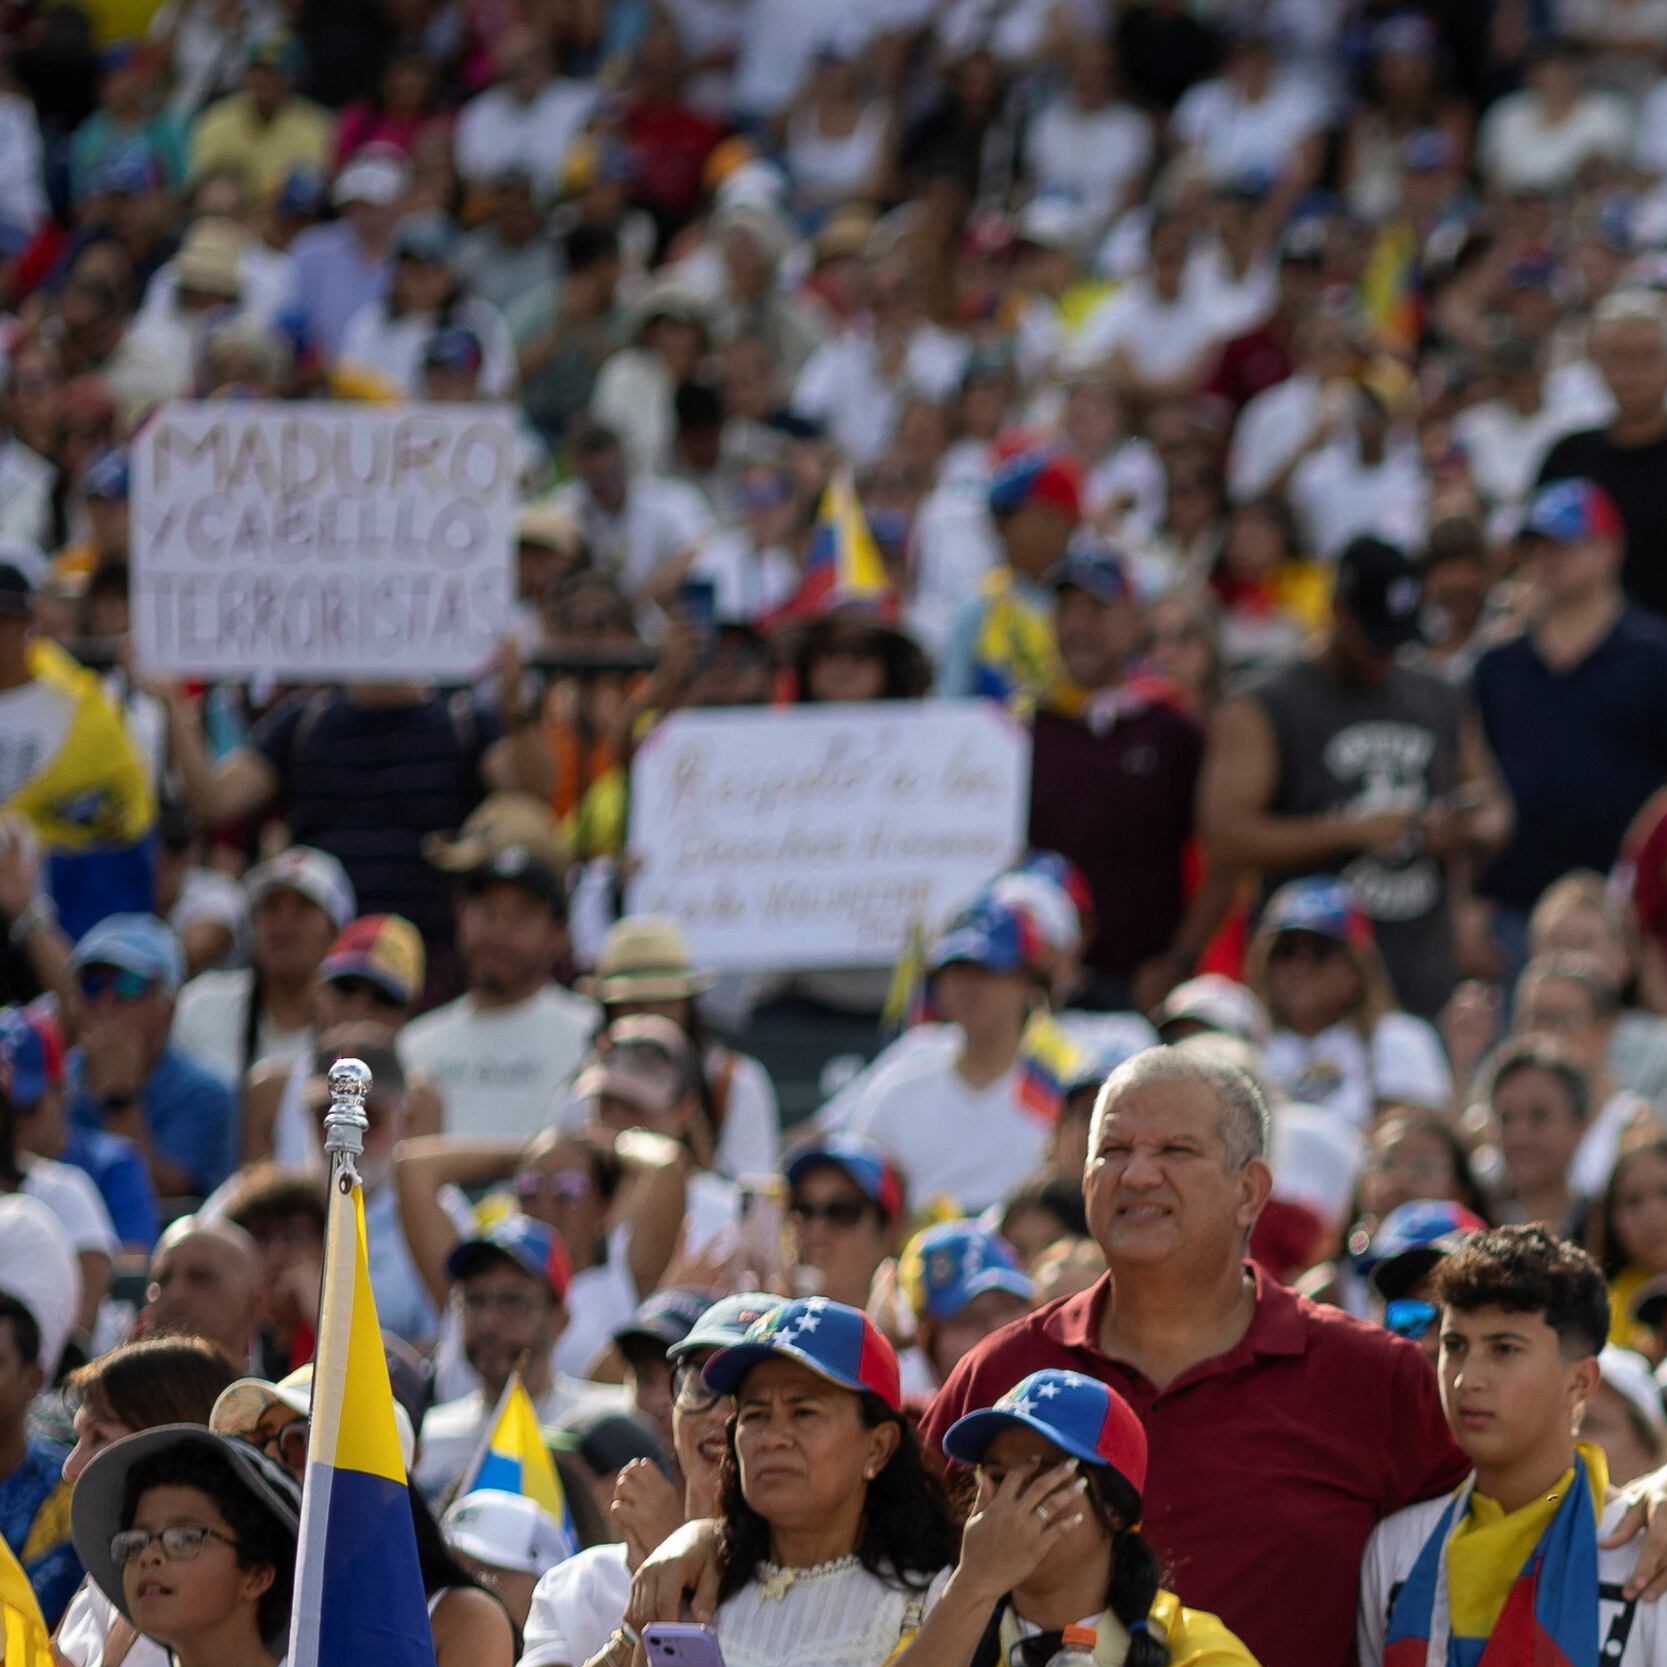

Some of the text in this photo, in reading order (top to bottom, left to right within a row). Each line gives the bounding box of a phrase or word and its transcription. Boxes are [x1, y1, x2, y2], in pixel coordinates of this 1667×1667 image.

[152, 420, 513, 495] MADURO
[184, 492, 492, 570] CABELLO
[143, 566, 513, 662] TERRORISTAS
